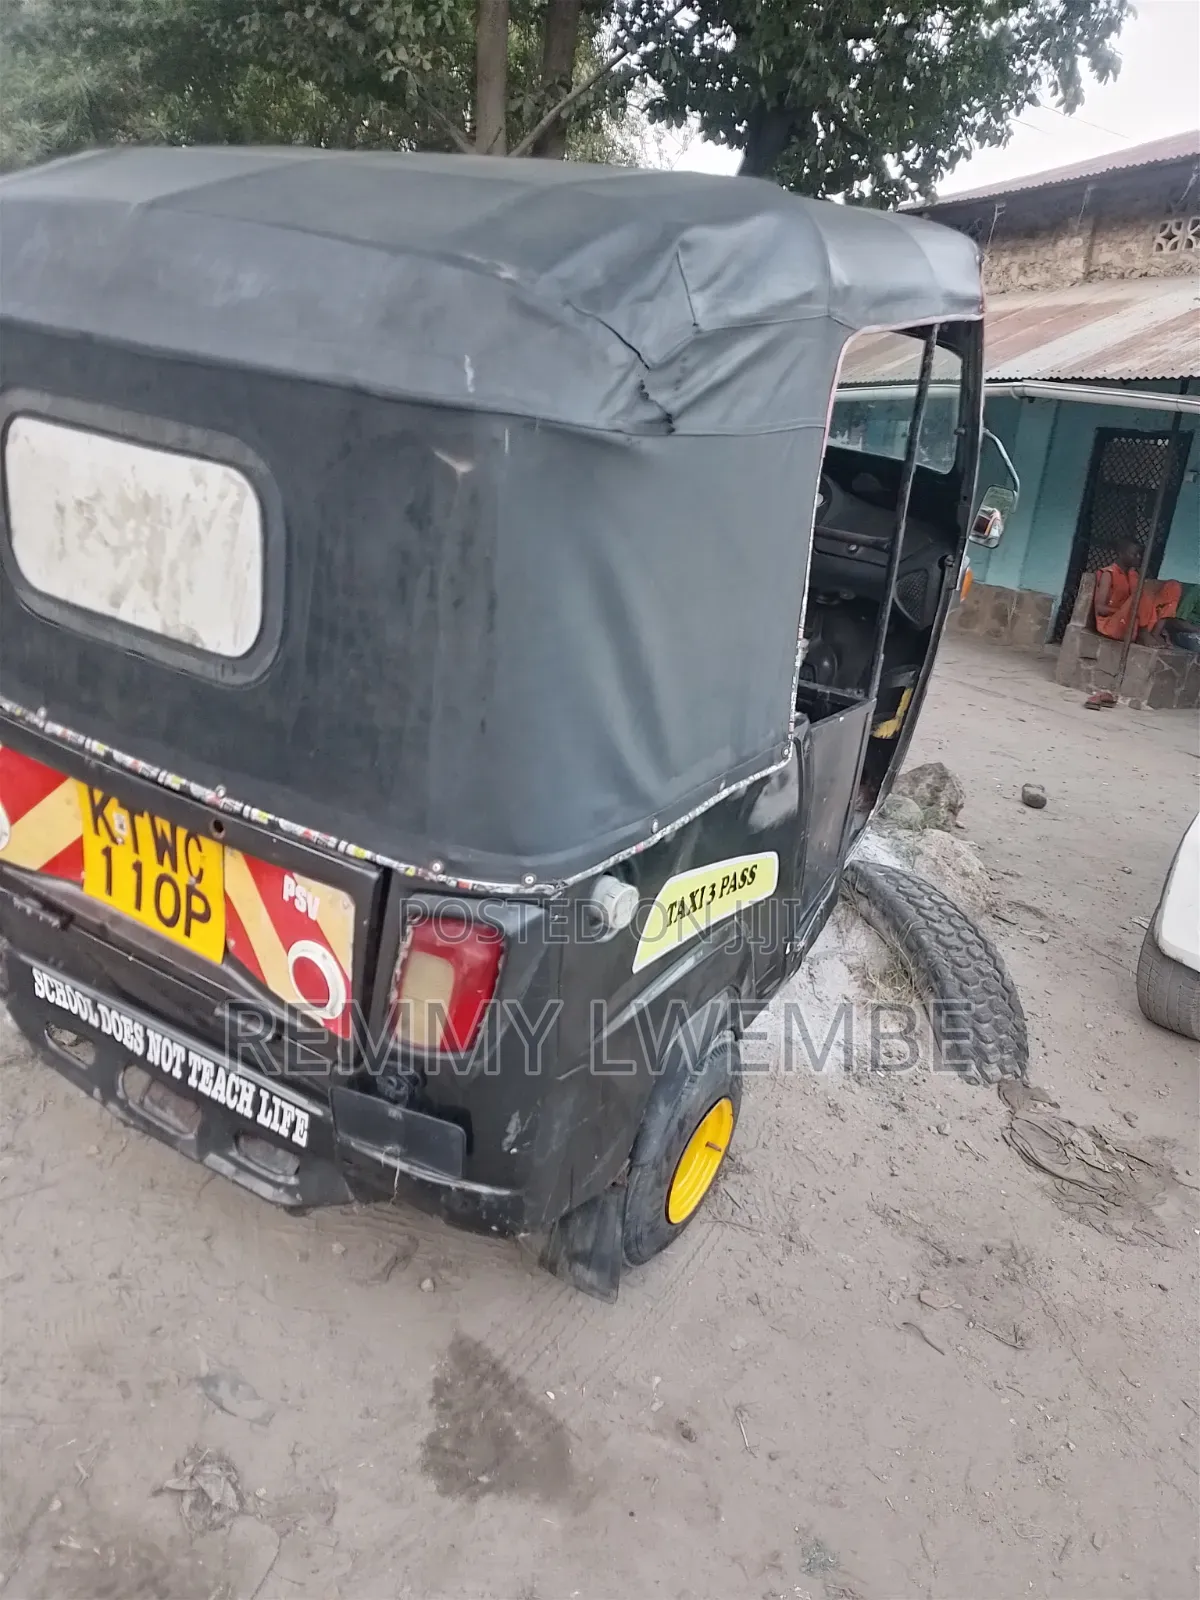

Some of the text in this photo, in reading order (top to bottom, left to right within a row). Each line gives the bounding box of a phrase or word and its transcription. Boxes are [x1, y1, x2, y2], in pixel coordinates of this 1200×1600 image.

[87, 787, 204, 885] KTWC
[102, 846, 211, 938] 110P
[282, 873, 321, 921] PSV
[666, 864, 758, 928] TAXI 3 PASS
[32, 966, 310, 1148] SCHOOL DOES NOT TEACH LIFE
